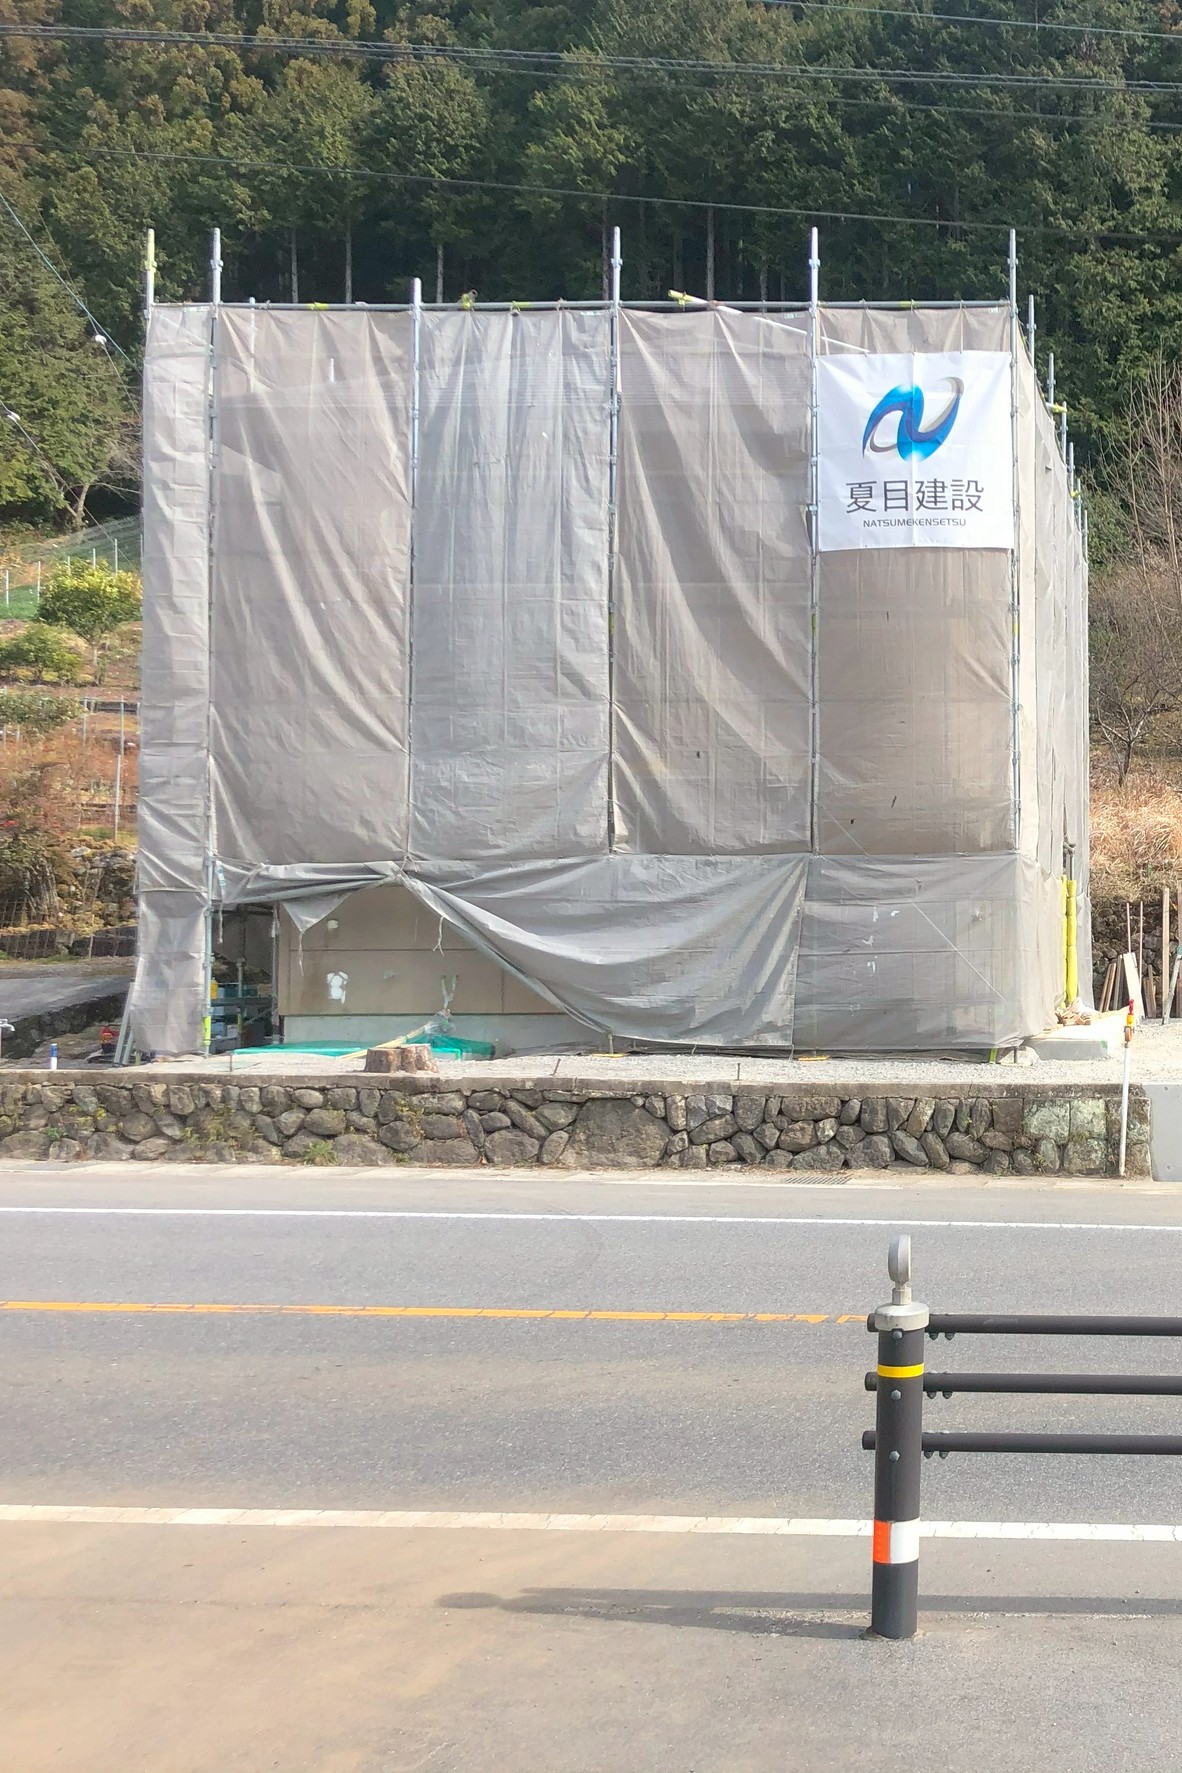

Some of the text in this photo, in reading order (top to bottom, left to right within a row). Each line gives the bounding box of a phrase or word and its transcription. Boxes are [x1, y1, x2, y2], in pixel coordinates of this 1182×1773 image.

[846, 478, 984, 514] 夏目建設
[863, 518, 966, 527] NATSUMEKENSETSU
